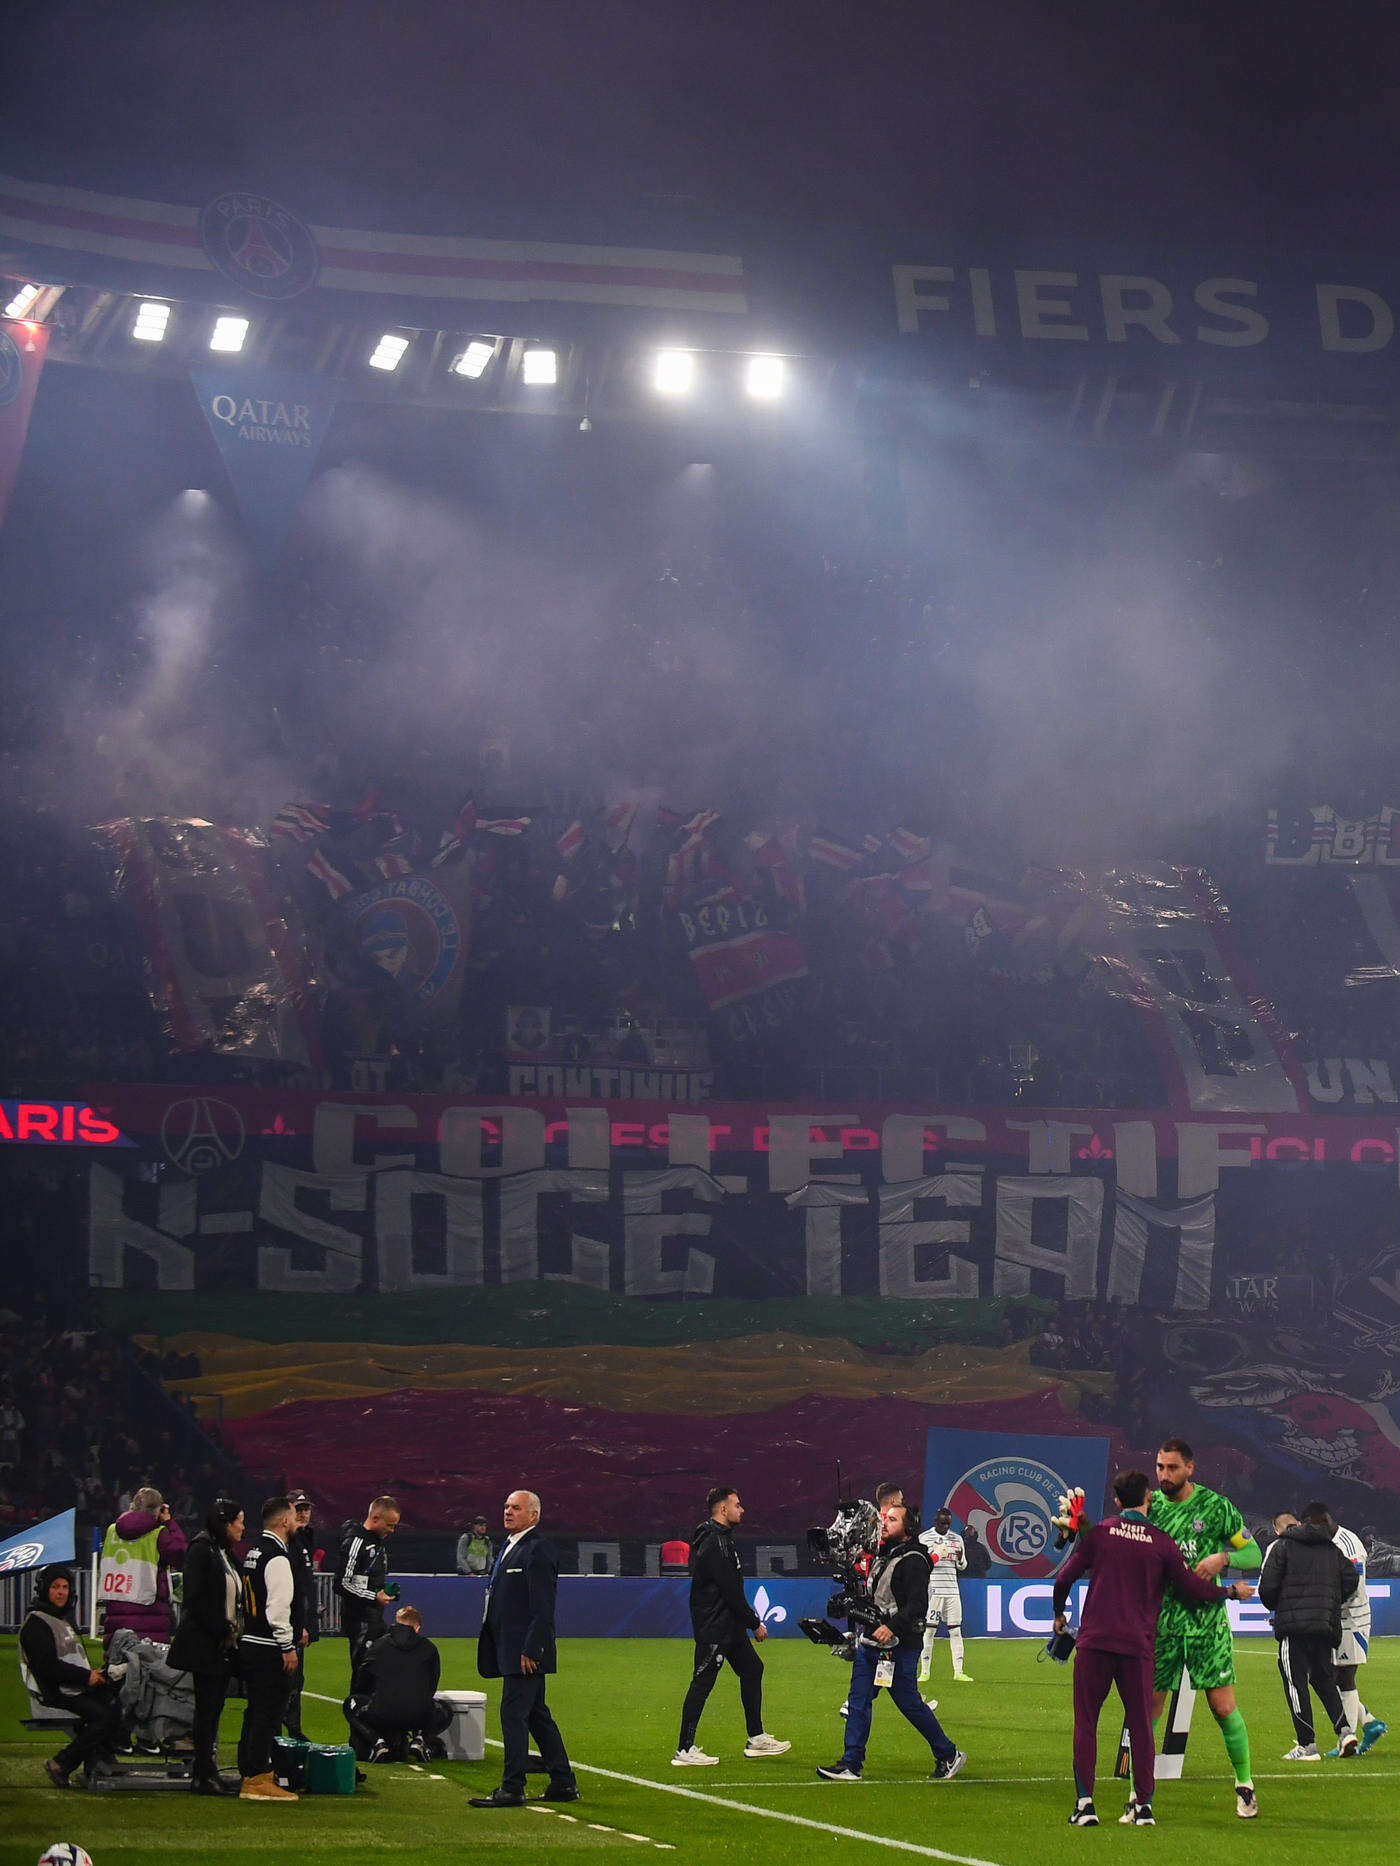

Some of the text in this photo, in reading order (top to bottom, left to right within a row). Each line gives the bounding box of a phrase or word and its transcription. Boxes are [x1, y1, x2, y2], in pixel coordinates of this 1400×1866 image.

[891, 264, 1271, 348] FIERS
[212, 394, 311, 430] QATAR
[239, 425, 313, 448] AIRWAYS
[1306, 1055, 1399, 1104] UN
[311, 1100, 1270, 1200] COLLECTIF
[88, 1160, 1217, 1312] K-SOCE TEAM
[980, 1466, 1015, 1482] RACING
[1018, 1468, 1043, 1482] CLUB
[1108, 1526, 1154, 1545] RWANDA
[1120, 1521, 1146, 1535] VISIT
[104, 1572, 126, 1593] 02
